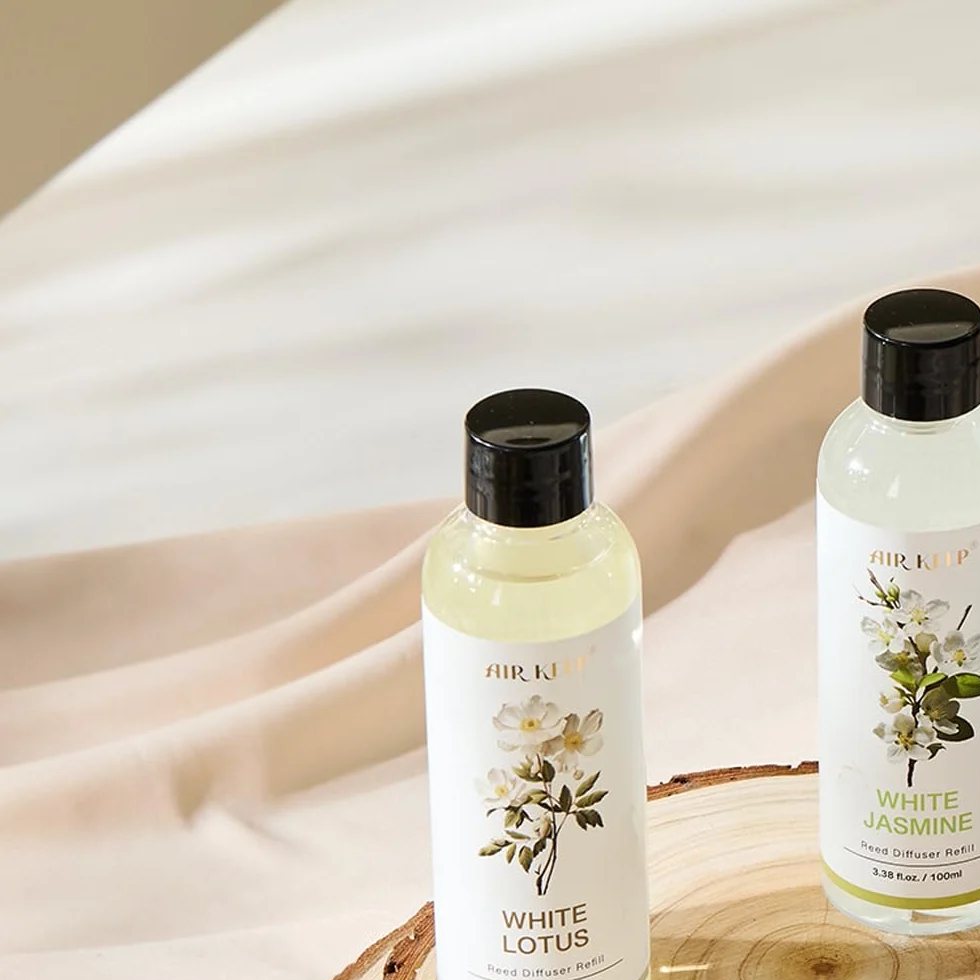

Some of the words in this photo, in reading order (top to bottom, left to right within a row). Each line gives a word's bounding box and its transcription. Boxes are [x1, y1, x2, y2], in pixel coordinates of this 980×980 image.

[870, 549, 912, 571] AIR
[485, 662, 531, 682] AIR
[876, 789, 958, 811] WHITE
[864, 812, 972, 836] JASMINE
[861, 841, 888, 856] Reed
[893, 848, 940, 859] Diffuser
[945, 844, 975, 857] Refill
[873, 868, 894, 880] 3.38
[896, 873, 920, 882] fl.oz.
[931, 870, 962, 881] 100ml
[502, 903, 587, 930] WHITE
[503, 928, 589, 955] LOTUS
[487, 963, 517, 978] Reed
[522, 966, 571, 978] Diffuser
[576, 954, 605, 971] Refill
